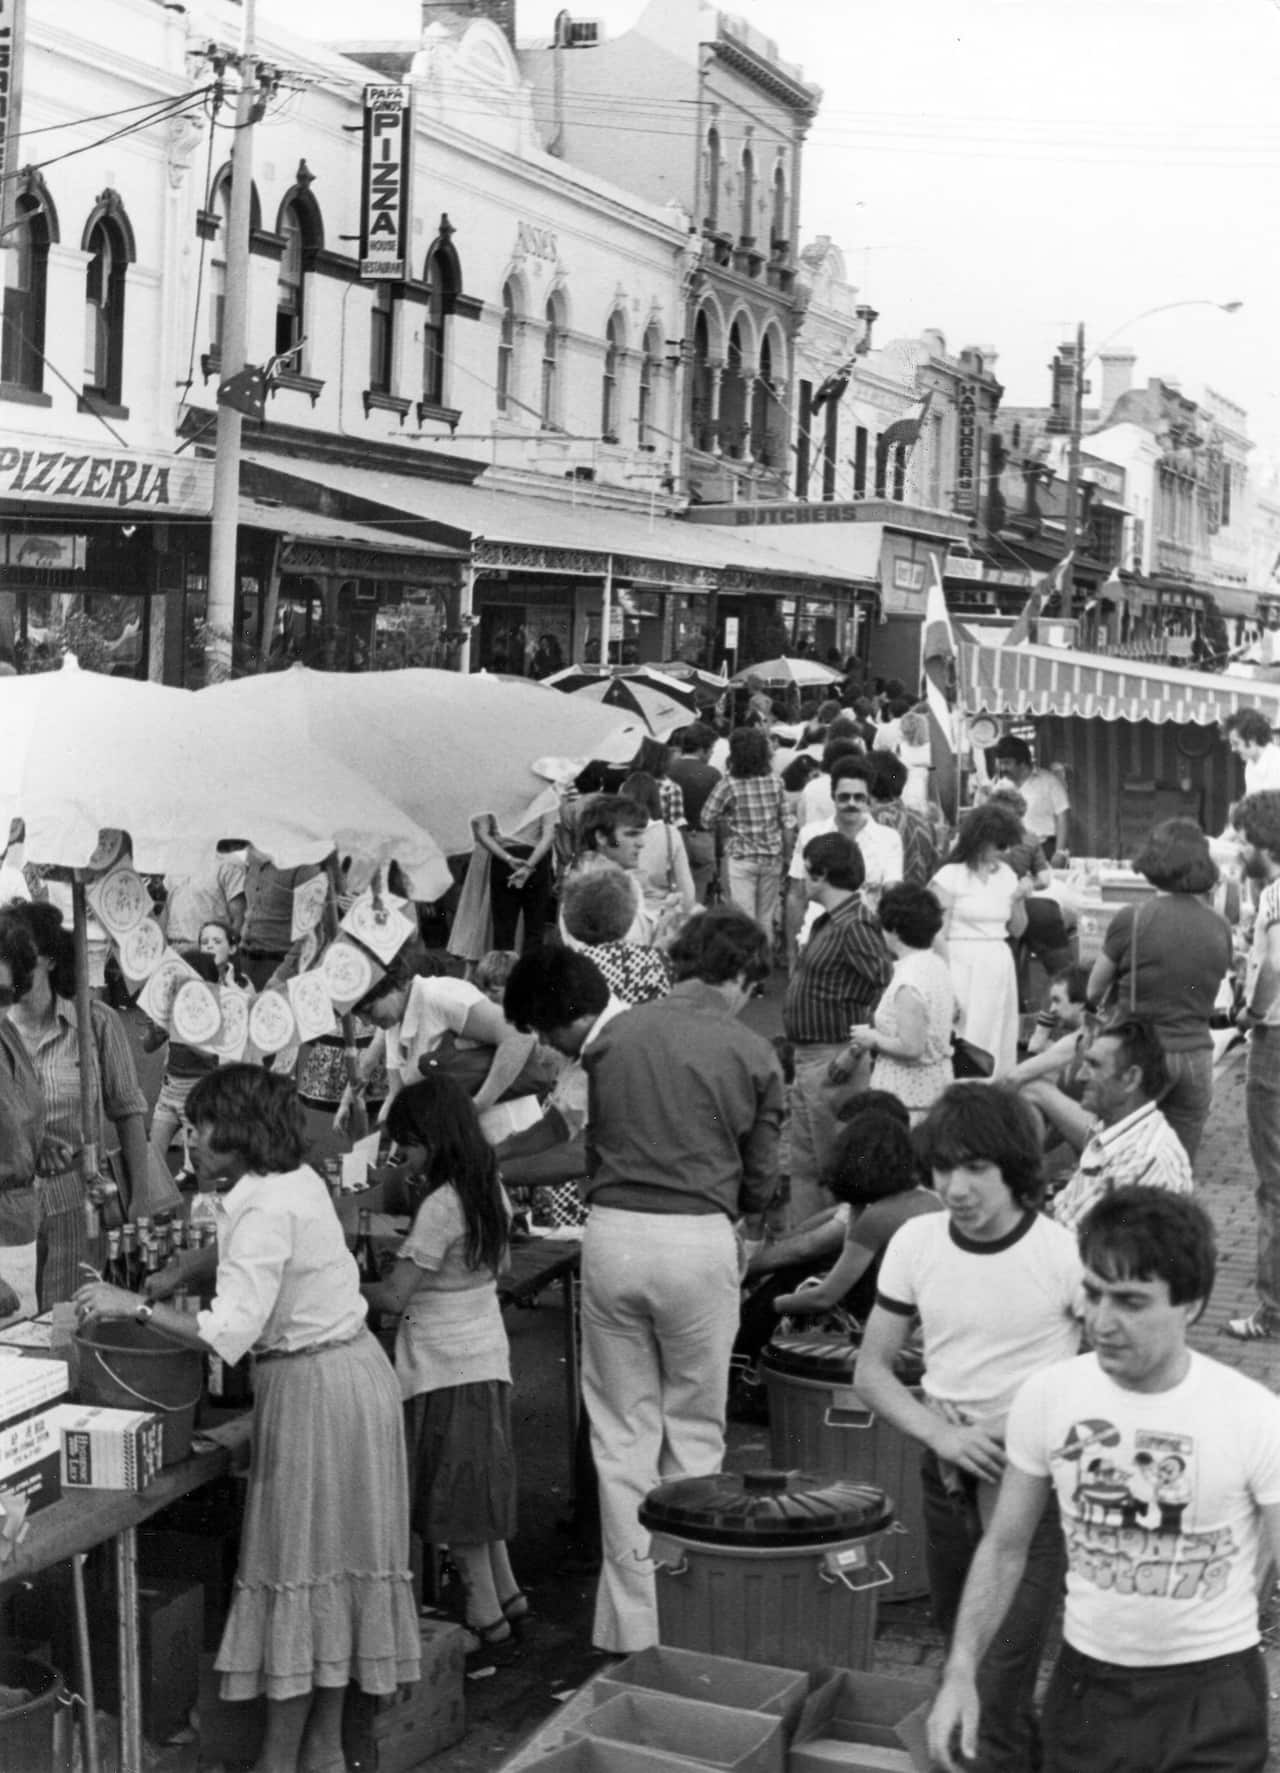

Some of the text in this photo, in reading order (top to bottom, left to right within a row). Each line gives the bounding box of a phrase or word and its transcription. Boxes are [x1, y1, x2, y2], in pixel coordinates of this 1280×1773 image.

[371, 88, 404, 99] PAPA
[370, 113, 400, 235] PIZZA
[370, 240, 396, 251] HOUSE
[959, 385, 976, 489] HAMBURGERS
[0, 447, 170, 506] PIZZERIA
[735, 505, 857, 525] BUTCHERS
